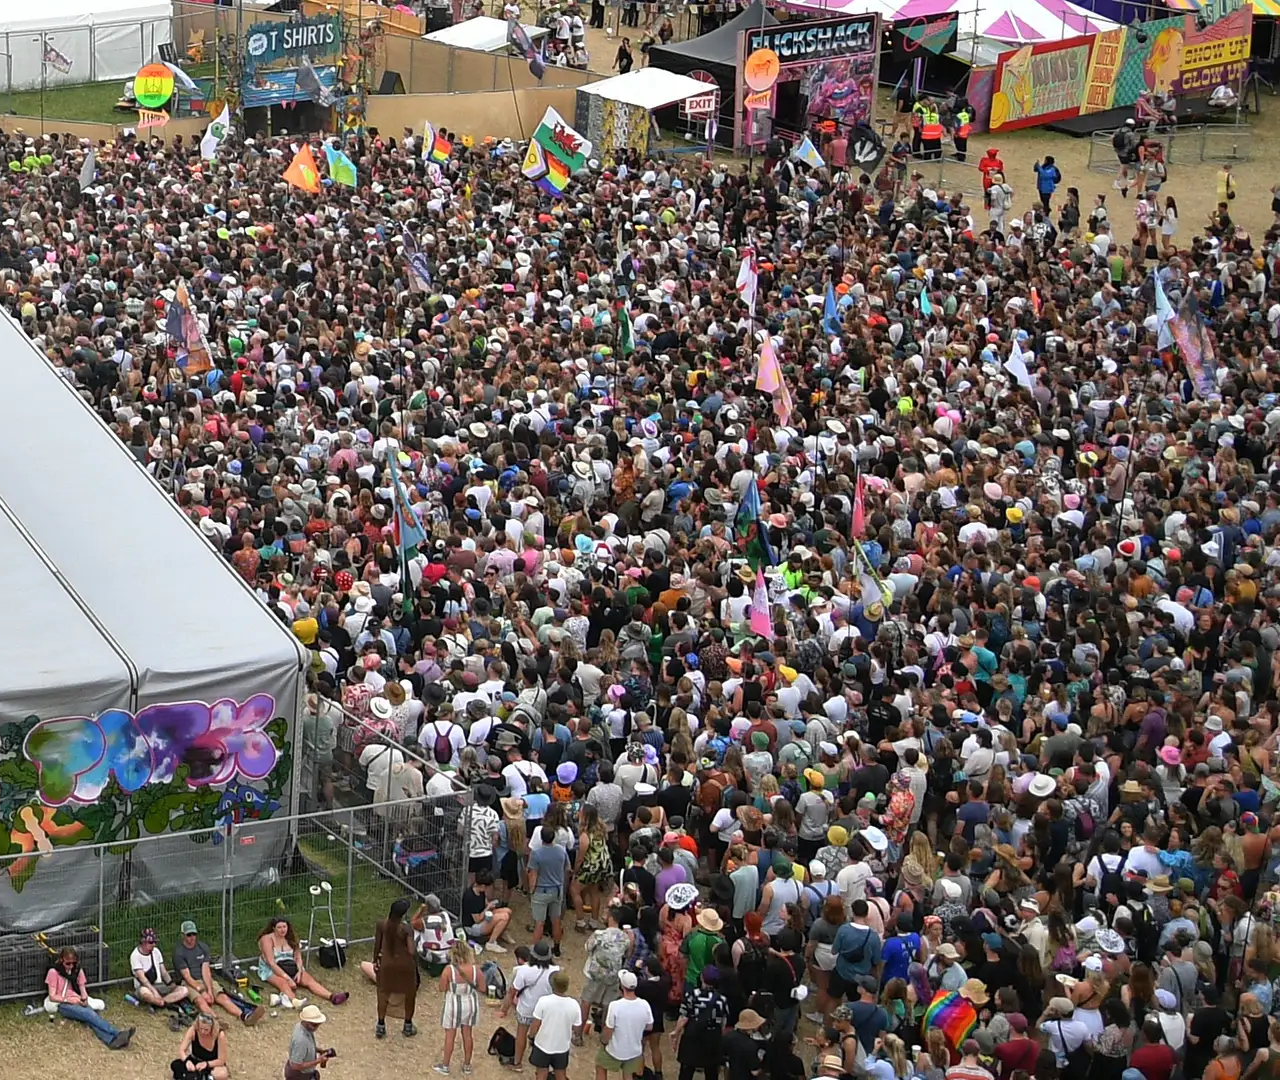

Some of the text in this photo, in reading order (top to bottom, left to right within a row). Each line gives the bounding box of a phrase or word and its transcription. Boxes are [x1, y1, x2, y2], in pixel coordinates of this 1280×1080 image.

[269, 23, 334, 50] T SHIRTS
[751, 21, 871, 57] FLICKSHACK
[1185, 38, 1248, 64] SHOW UP
[1181, 67, 1222, 90] GLOW
[689, 99, 713, 109] EXIT
[24, 693, 277, 807] PARK
